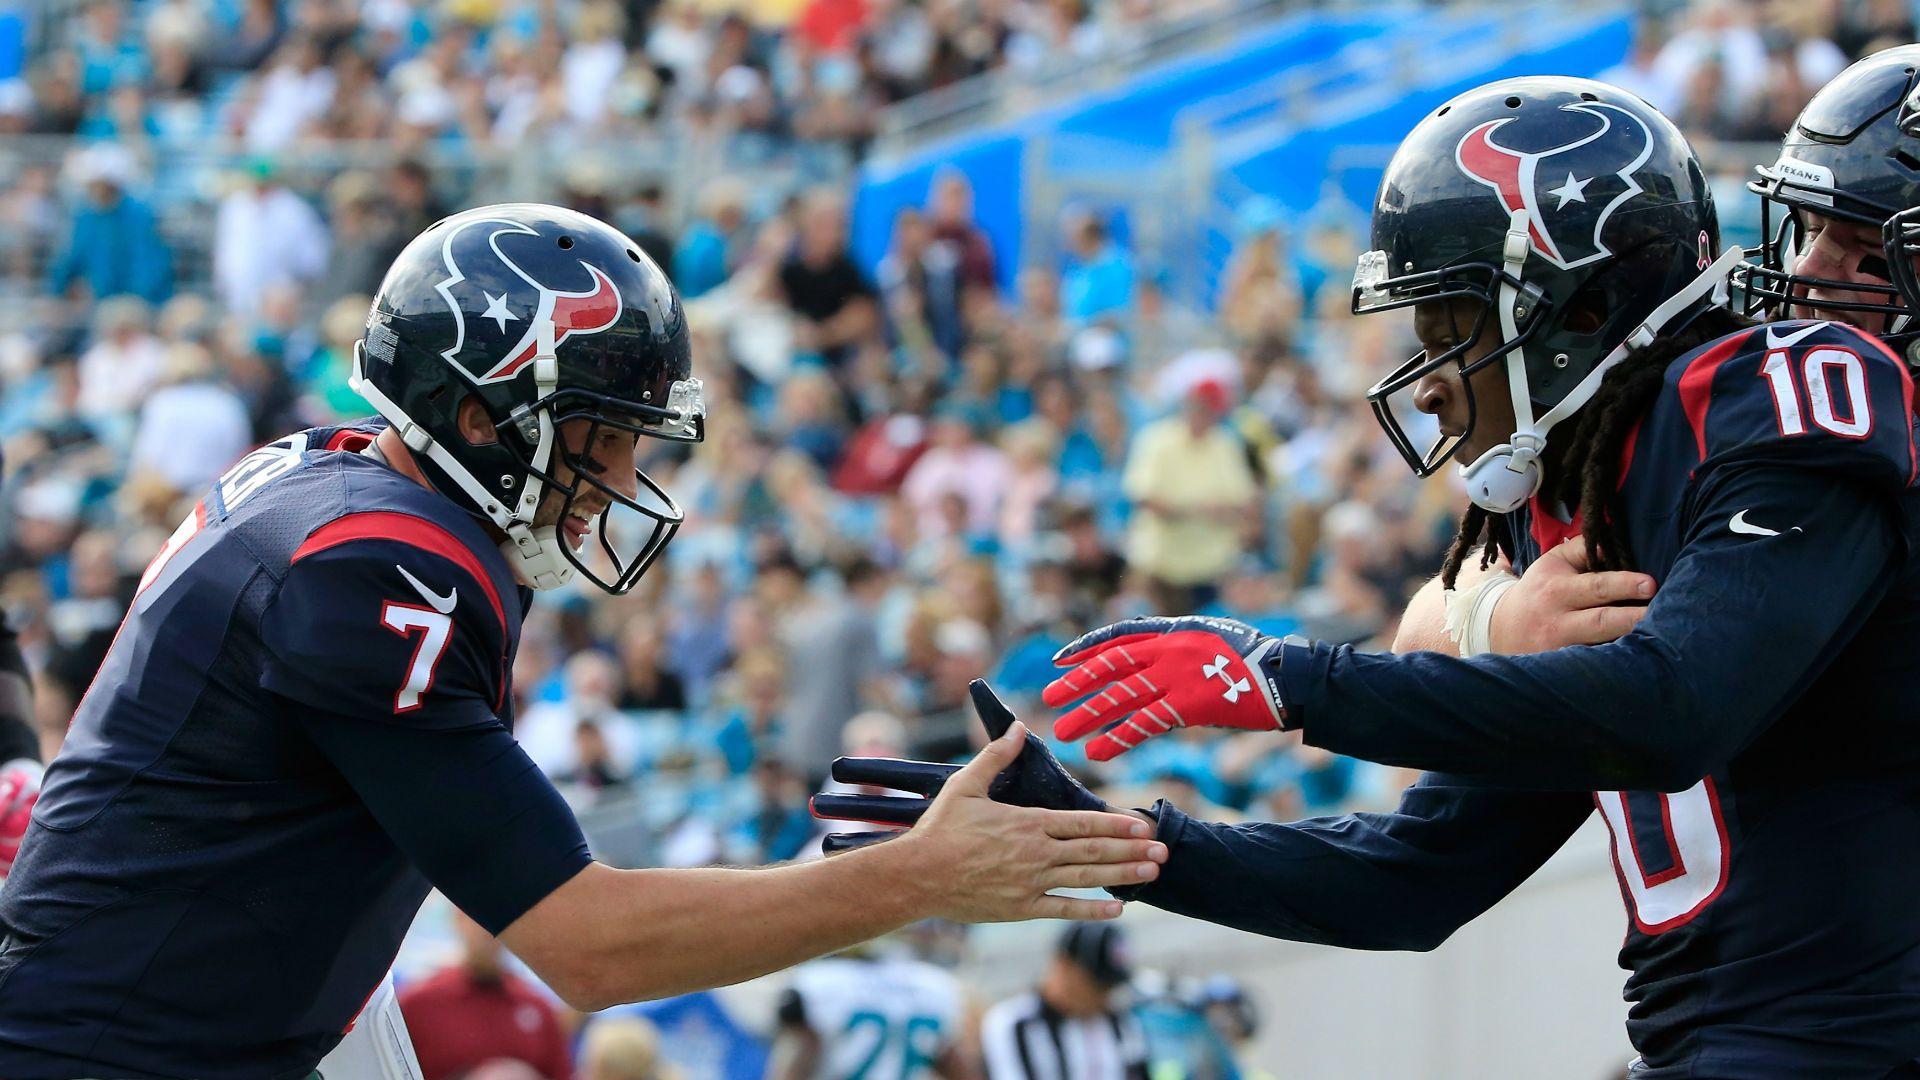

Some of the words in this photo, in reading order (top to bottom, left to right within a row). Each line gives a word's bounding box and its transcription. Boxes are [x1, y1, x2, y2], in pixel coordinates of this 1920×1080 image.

[1780, 164, 1821, 182] TEXANS
[1757, 345, 1875, 440] 10
[380, 600, 455, 714] 7
